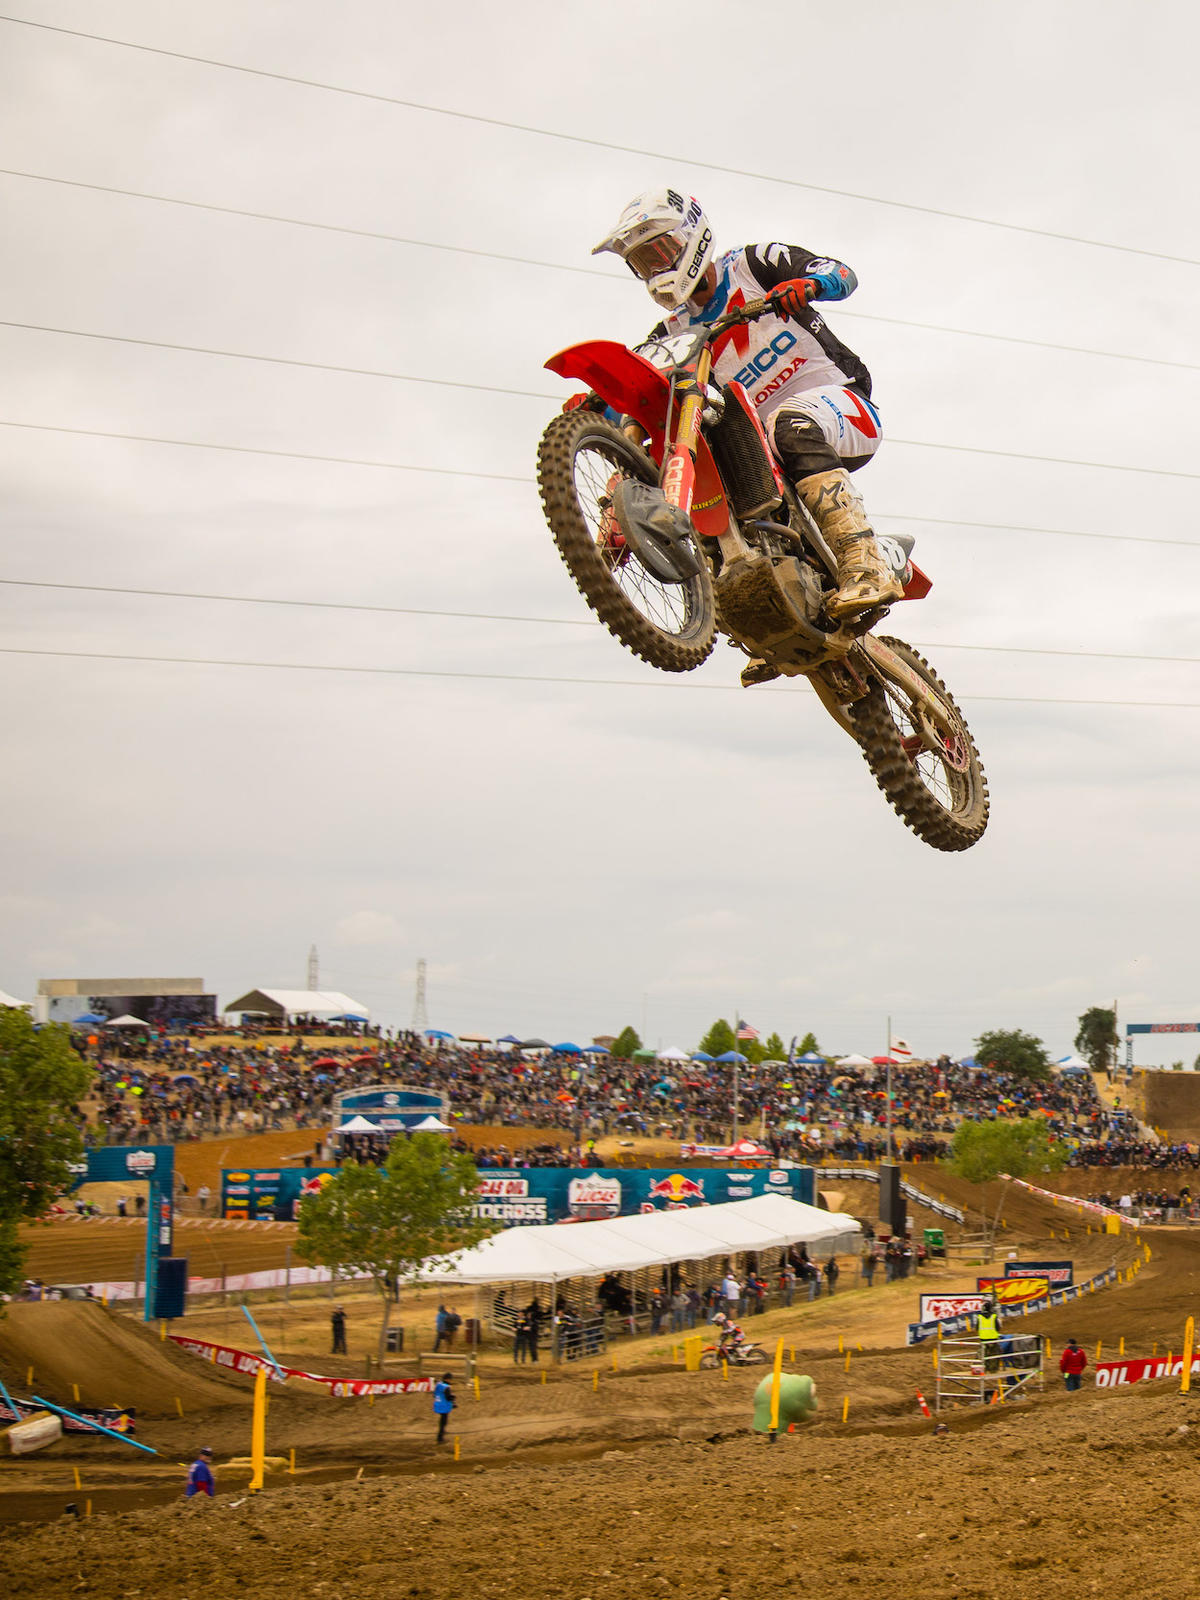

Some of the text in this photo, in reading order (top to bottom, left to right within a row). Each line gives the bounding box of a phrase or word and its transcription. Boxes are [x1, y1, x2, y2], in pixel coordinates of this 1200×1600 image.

[667, 189, 684, 214] 38
[687, 228, 712, 279] GEICO
[723, 330, 798, 390] EICO
[821, 395, 845, 439] GEICO
[505, 1180, 524, 1195] OIL
[576, 1190, 617, 1202] LUCAS
[1096, 1368, 1130, 1387] OIL
